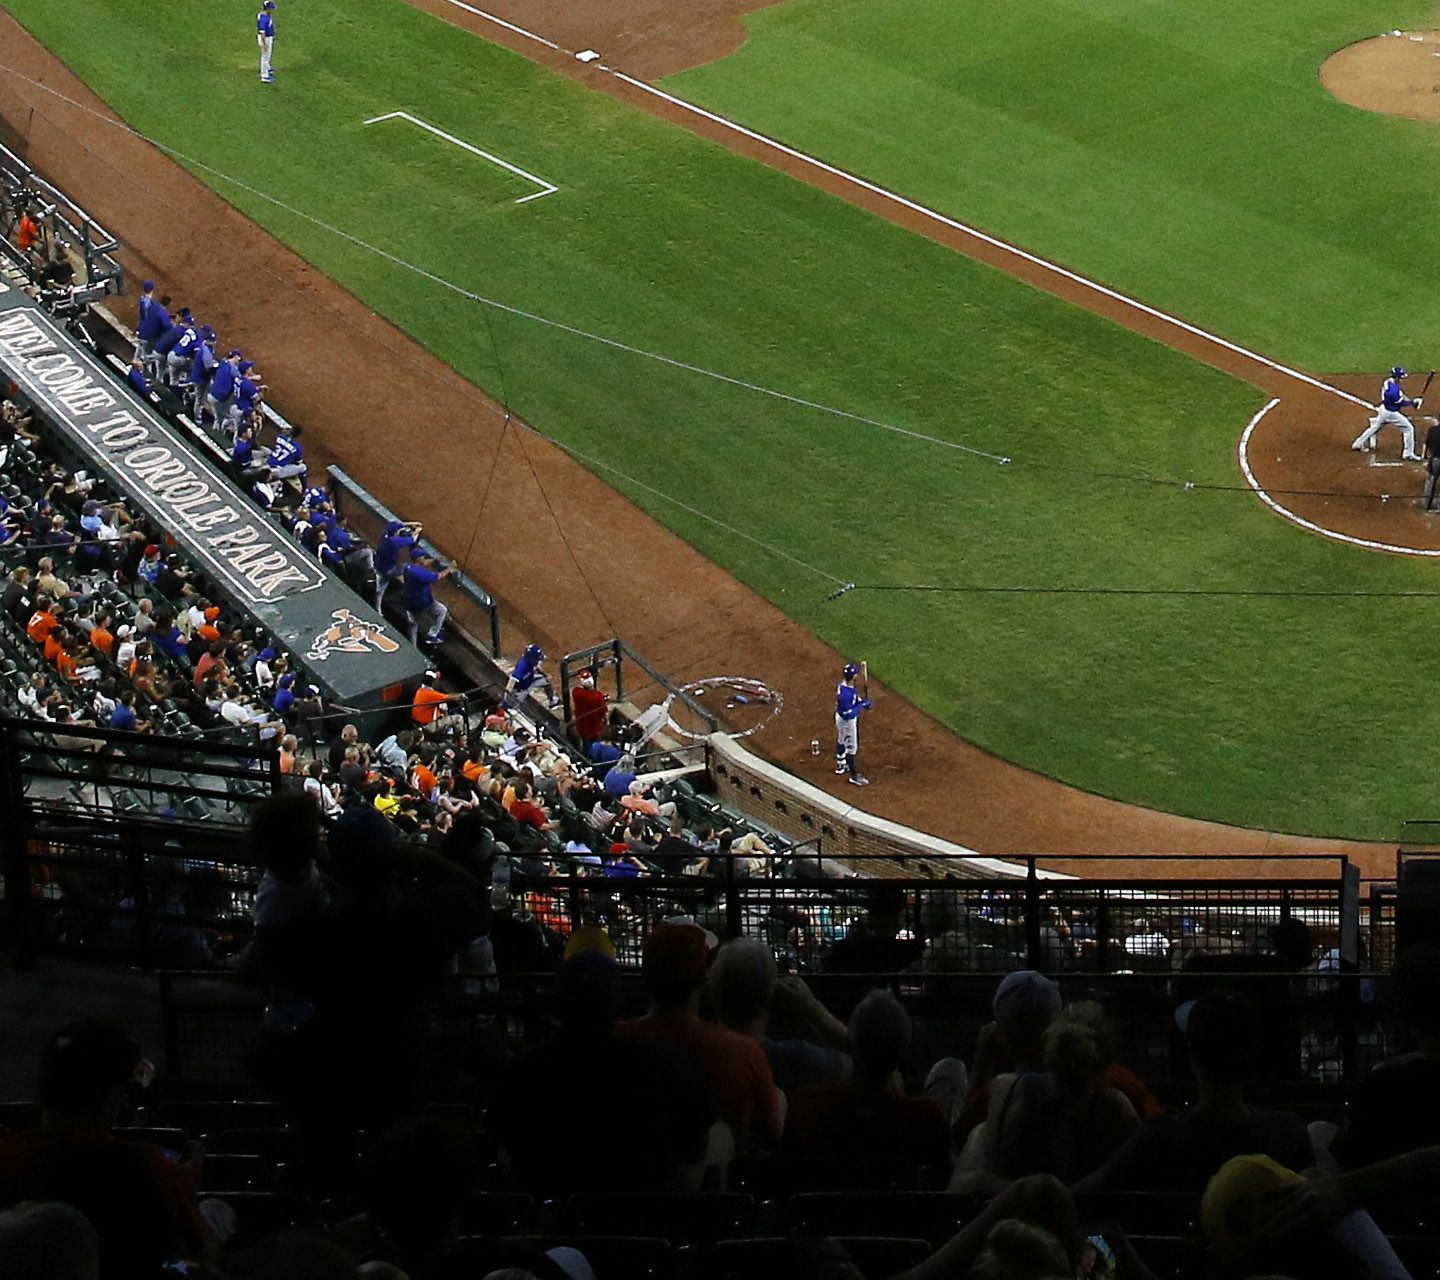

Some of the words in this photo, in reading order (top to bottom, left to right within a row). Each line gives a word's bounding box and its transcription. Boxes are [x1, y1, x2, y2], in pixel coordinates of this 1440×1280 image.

[89, 410, 149, 449] TO
[123, 446, 241, 533] ORIOLE
[210, 526, 309, 596] PARK
[271, 444, 291, 461] 37
